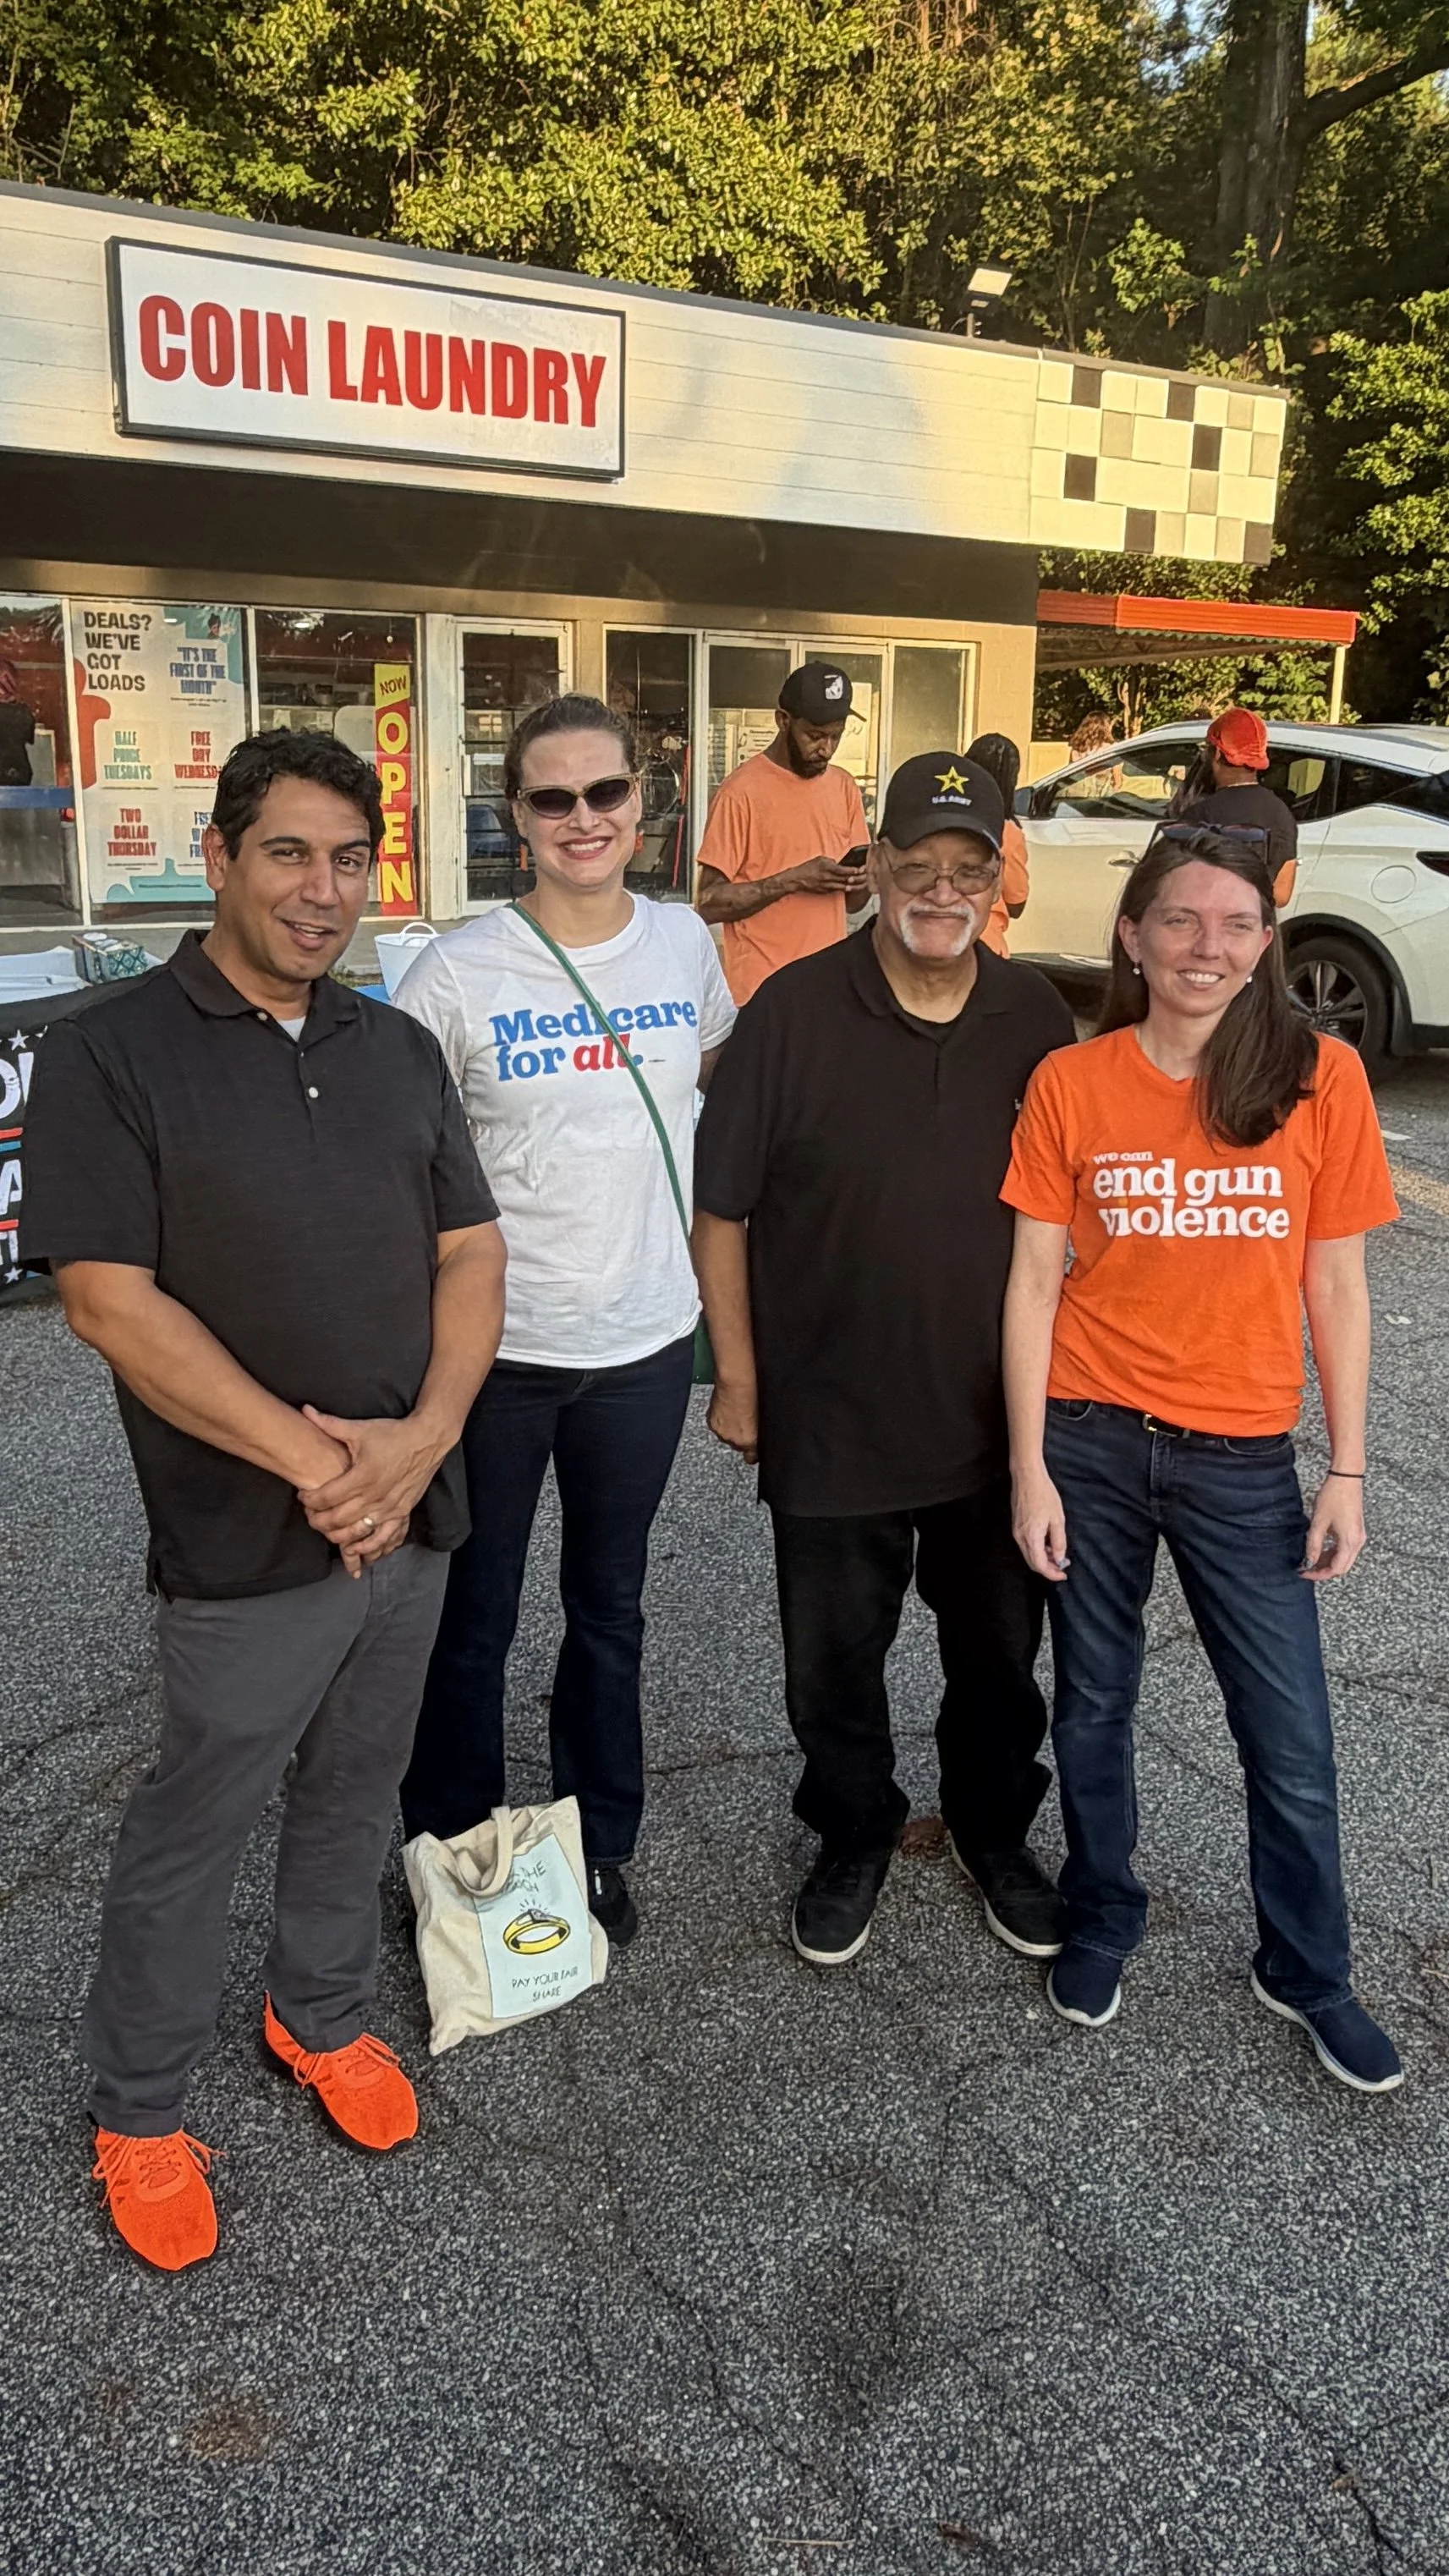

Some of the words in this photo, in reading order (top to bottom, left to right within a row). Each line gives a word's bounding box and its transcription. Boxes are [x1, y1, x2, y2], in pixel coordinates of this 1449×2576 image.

[139, 294, 309, 396] COIN
[327, 320, 606, 428] LAUNDRY
[84, 611, 152, 631] DEALS?
[85, 633, 140, 651] WE'VE
[86, 653, 122, 670] GOT
[87, 673, 145, 692] LOADS
[380, 675, 407, 695] NOW
[114, 730, 137, 745] HALF
[190, 730, 211, 746] FREE
[119, 808, 142, 823] TWO
[377, 711, 414, 904] OPEN
[113, 824, 149, 840] DOLLAR
[107, 841, 157, 857] THURSDAY
[489, 1000, 698, 1047] Medicare
[496, 1045, 566, 1082] for
[1093, 1152, 1118, 1165] we
[1120, 1150, 1154, 1162] can
[1093, 1157, 1177, 1200] end
[1183, 1165, 1283, 1206] gun
[1100, 1198, 1289, 1238] violence
[512, 1977, 530, 1989] PAY
[533, 1971, 559, 1986] YOUR
